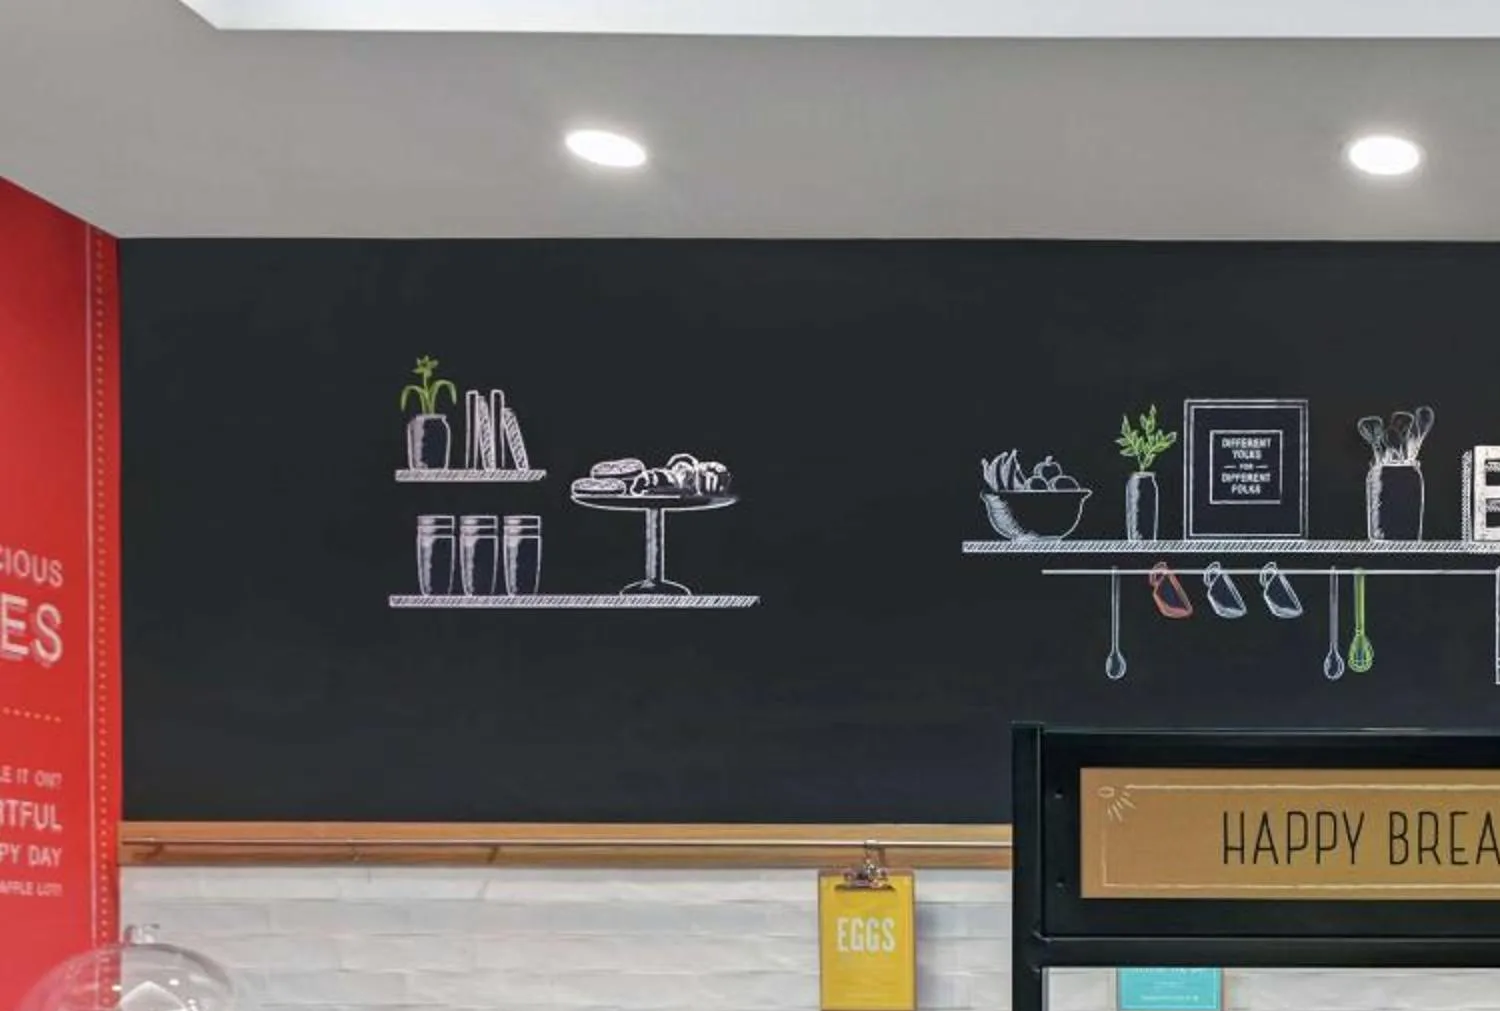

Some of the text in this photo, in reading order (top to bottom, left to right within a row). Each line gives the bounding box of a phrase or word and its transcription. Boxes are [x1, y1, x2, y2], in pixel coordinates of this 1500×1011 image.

[28, 844, 62, 868] DAY
[1222, 810, 1366, 866] HAPPY
[836, 916, 897, 953] EGGS
